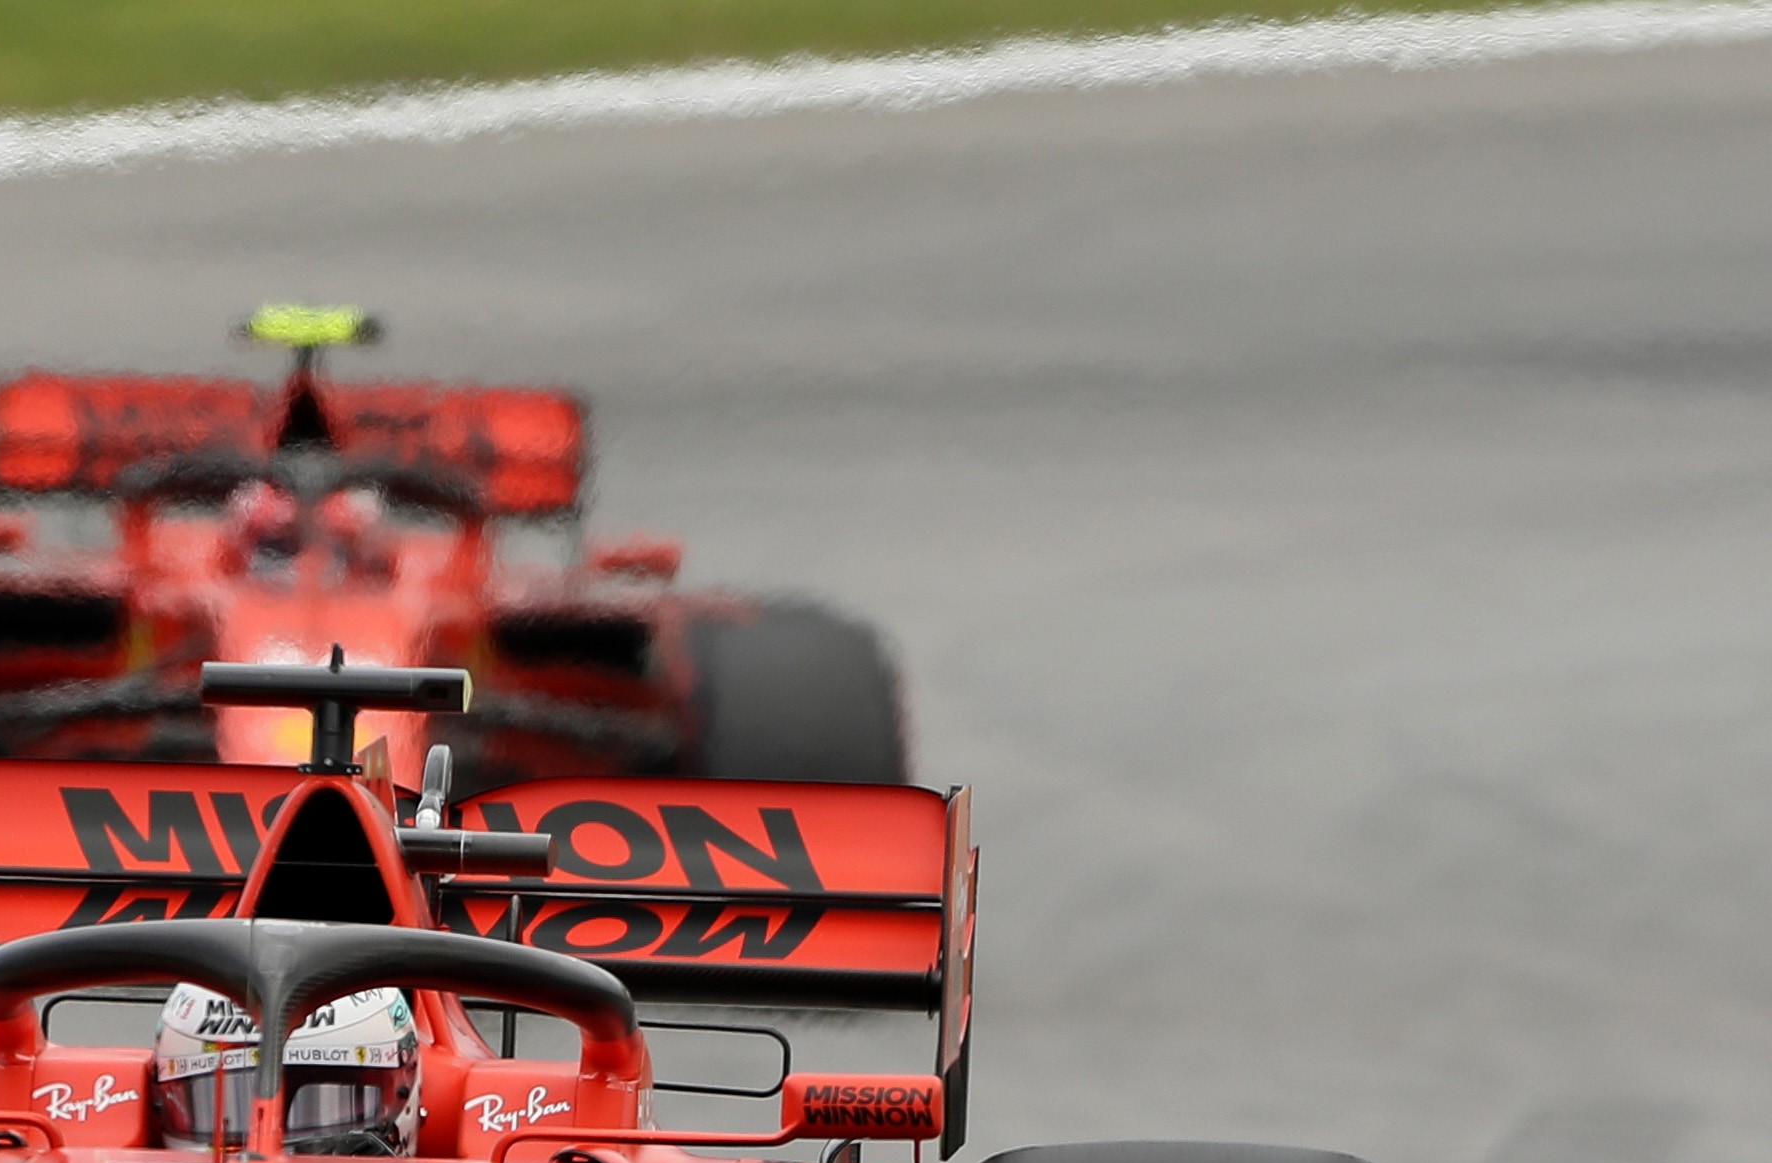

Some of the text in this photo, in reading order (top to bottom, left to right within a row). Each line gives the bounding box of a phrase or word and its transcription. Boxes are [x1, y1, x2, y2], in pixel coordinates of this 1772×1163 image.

[288, 1048, 349, 1061] HUBLOT
[804, 1085, 933, 1106] MISSION
[803, 1106, 934, 1127] WINNOW
